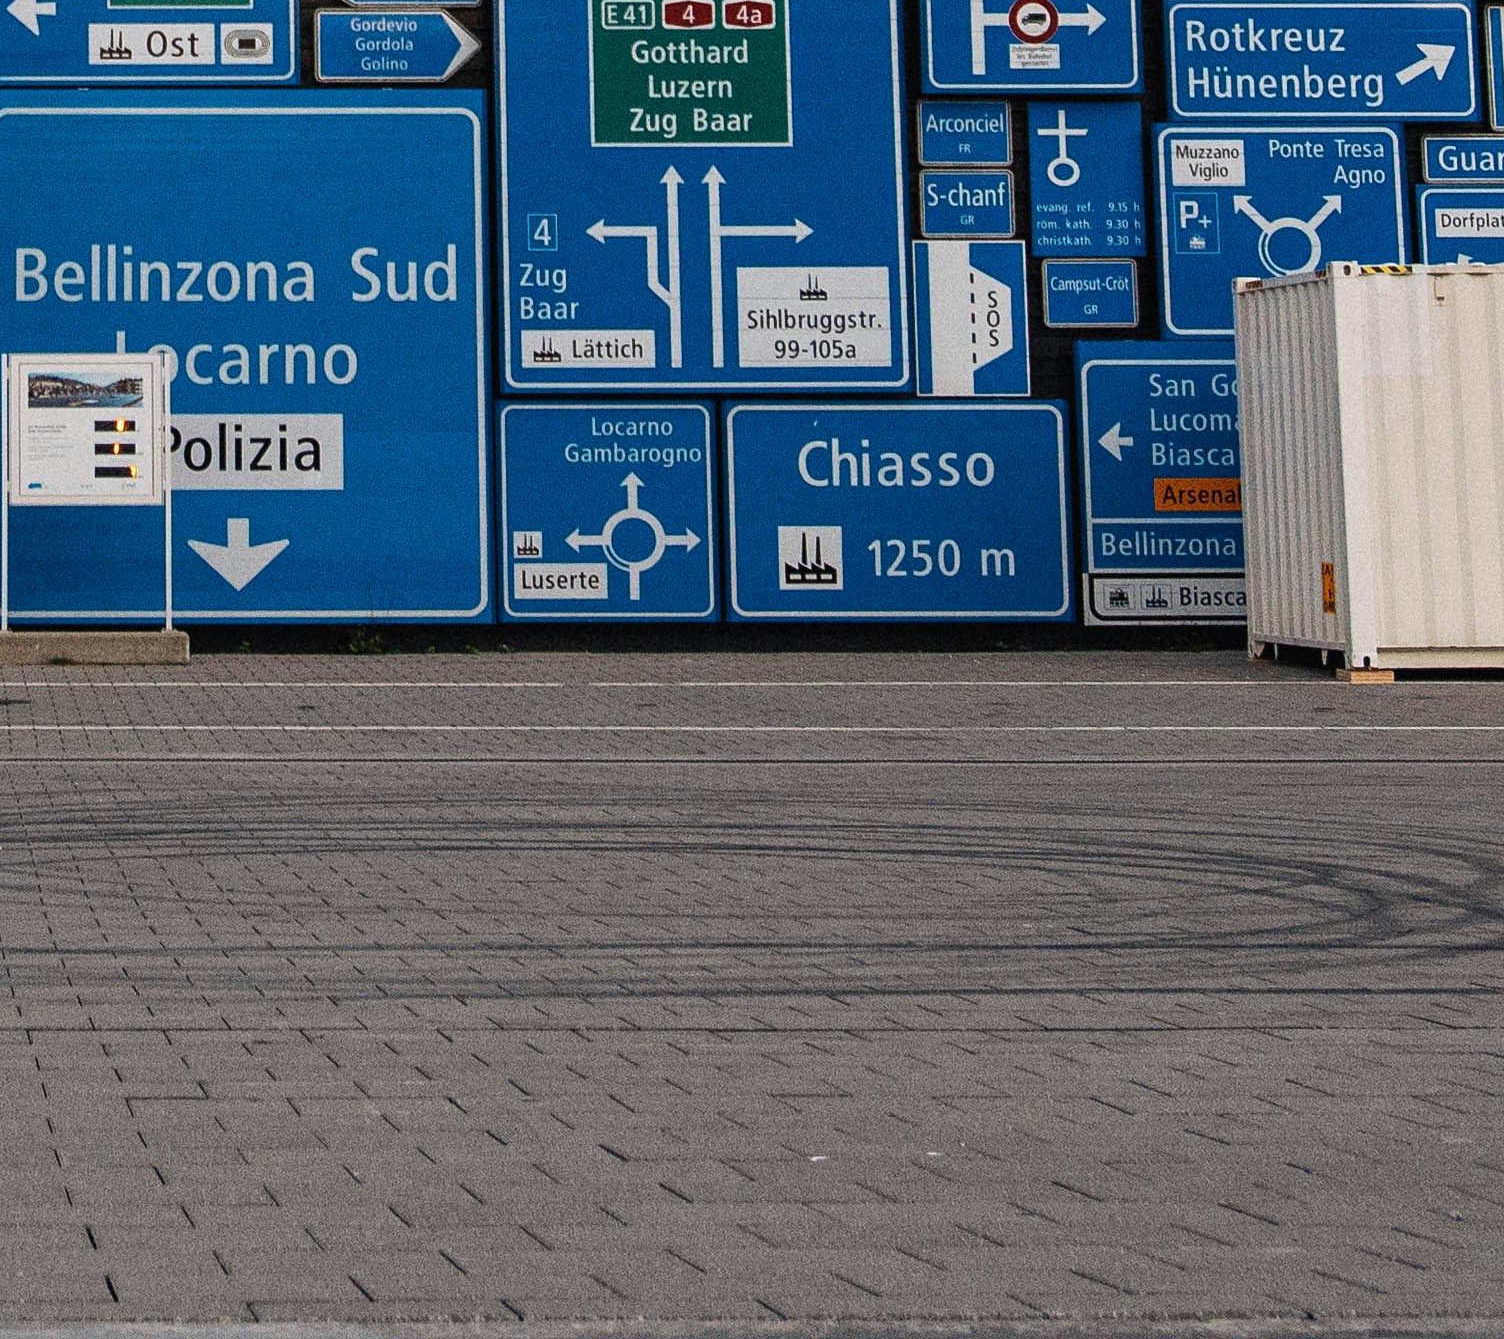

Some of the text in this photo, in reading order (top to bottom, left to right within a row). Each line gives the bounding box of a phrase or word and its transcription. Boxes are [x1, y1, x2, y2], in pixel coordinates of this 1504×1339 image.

[146, 30, 199, 58] Ost
[630, 38, 749, 64] Gotthard
[925, 113, 1004, 133] Arconciel
[1188, 162, 1229, 182] Viglio
[15, 243, 457, 302] Bellinzona Sud
[1050, 276, 1129, 295] Campsut-Crôt
[520, 296, 580, 320] Baar
[747, 308, 882, 335] Sihlbruggstr.
[591, 417, 673, 436] Locarno
[1151, 441, 1235, 466] Biasca
[867, 539, 1016, 577] 1250 m
[521, 569, 600, 590] Luserte
